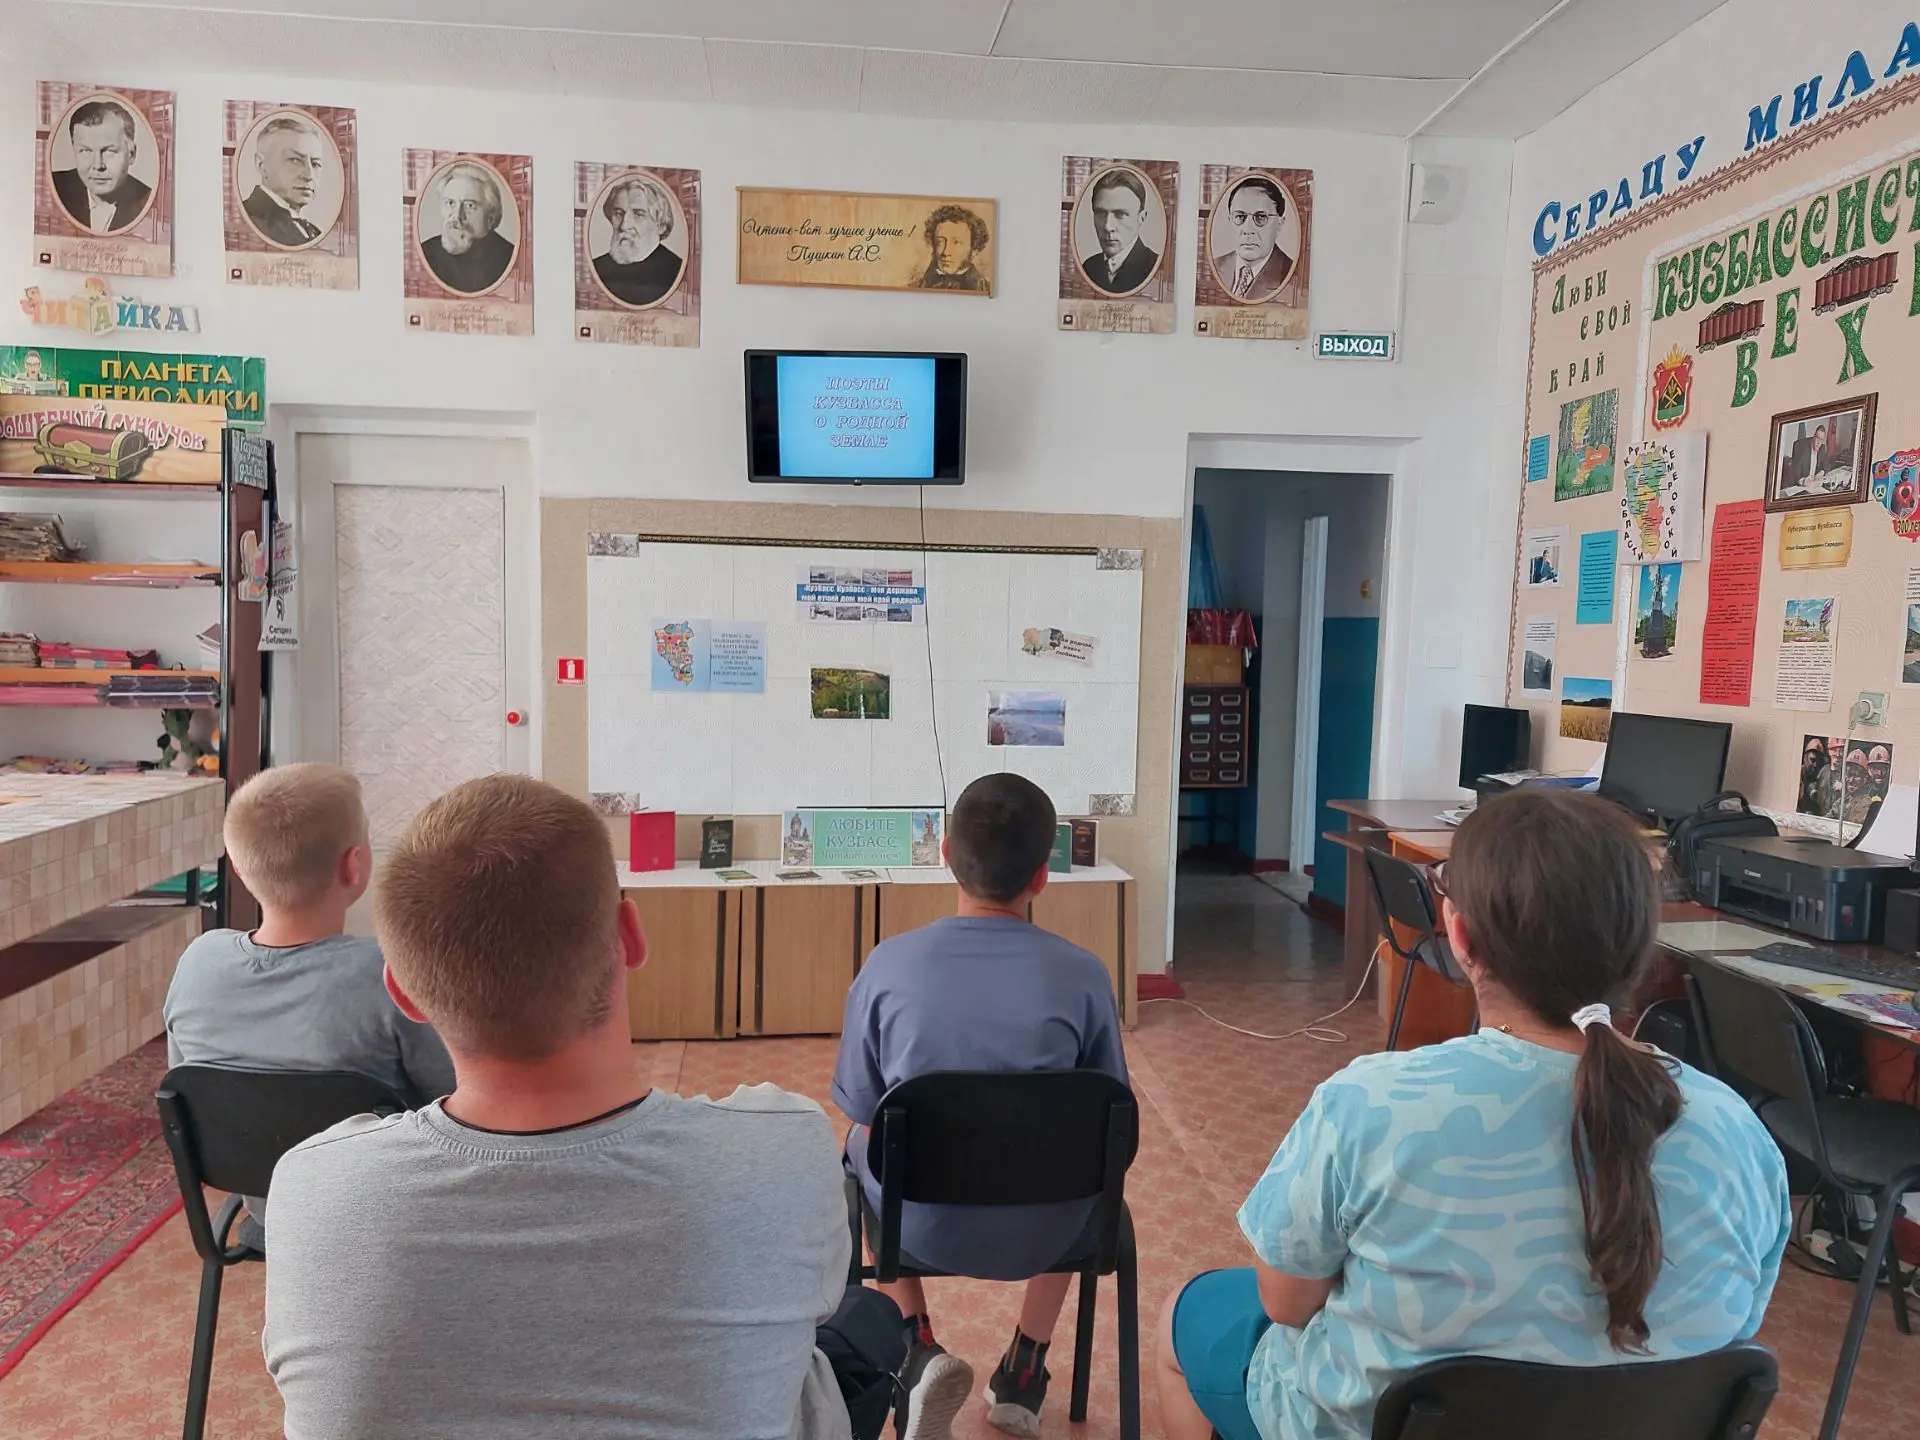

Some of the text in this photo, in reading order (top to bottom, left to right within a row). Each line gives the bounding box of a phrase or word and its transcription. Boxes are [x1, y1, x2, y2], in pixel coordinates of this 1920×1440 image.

[1321, 337, 1385, 355] ВЫХОД
[101, 359, 233, 385] ПЛАНЕТА
[826, 376, 890, 391] ПОЭТЫ
[812, 396, 903, 411] КУЗБАССА
[815, 412, 908, 430] О РОДНОЙ
[830, 435, 888, 449] ЗЕМЛЕ
[829, 818, 896, 831] ЛЮБИТЕ
[827, 835, 898, 848] КУЗБАСС
